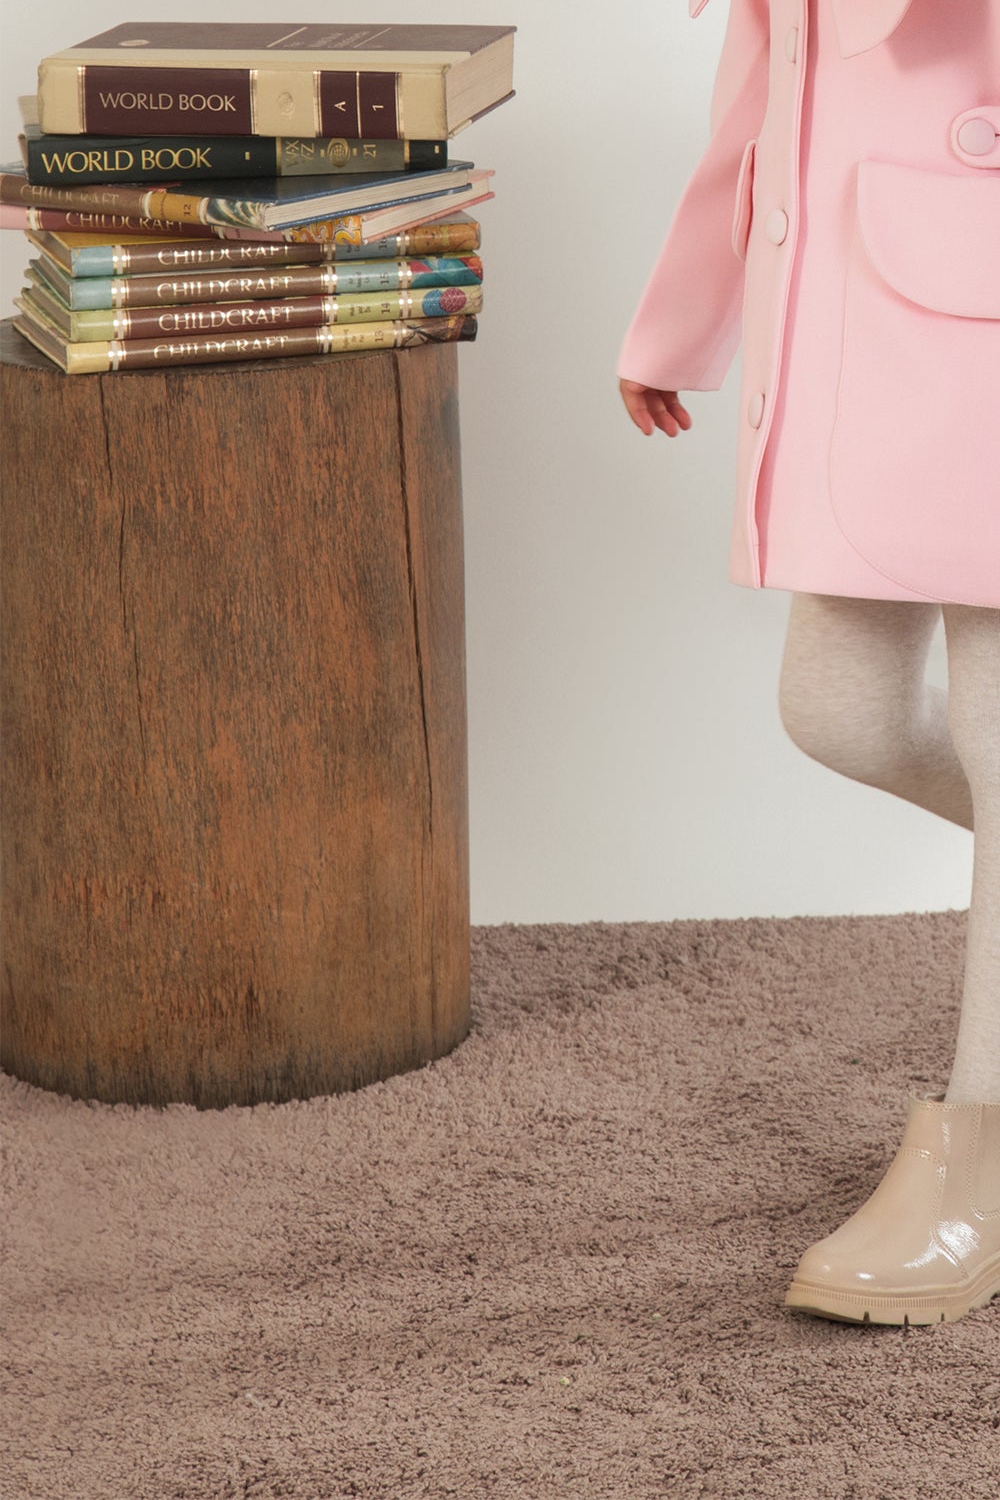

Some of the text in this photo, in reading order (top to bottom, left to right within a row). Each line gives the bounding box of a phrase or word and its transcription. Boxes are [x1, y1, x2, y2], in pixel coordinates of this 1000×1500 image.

[100, 92, 237, 112] WORLD BOOK
[334, 101, 347, 112] A
[372, 103, 385, 112] 1
[41, 147, 213, 174] WORLD BOOK
[362, 143, 377, 159] 21
[20, 184, 120, 206] CHILDCRAFT
[183, 203, 192, 217] 12
[65, 211, 184, 232] CHILDCRAFT
[157, 245, 289, 266] CHILDCRAFT
[156, 275, 293, 299] CHILDCRAFT
[380, 272, 390, 285] 15
[158, 305, 295, 331] CHILDCRAFT
[381, 302, 391, 315] 14
[374, 330, 384, 343] 13
[153, 335, 289, 359] CHILDCRAFT
